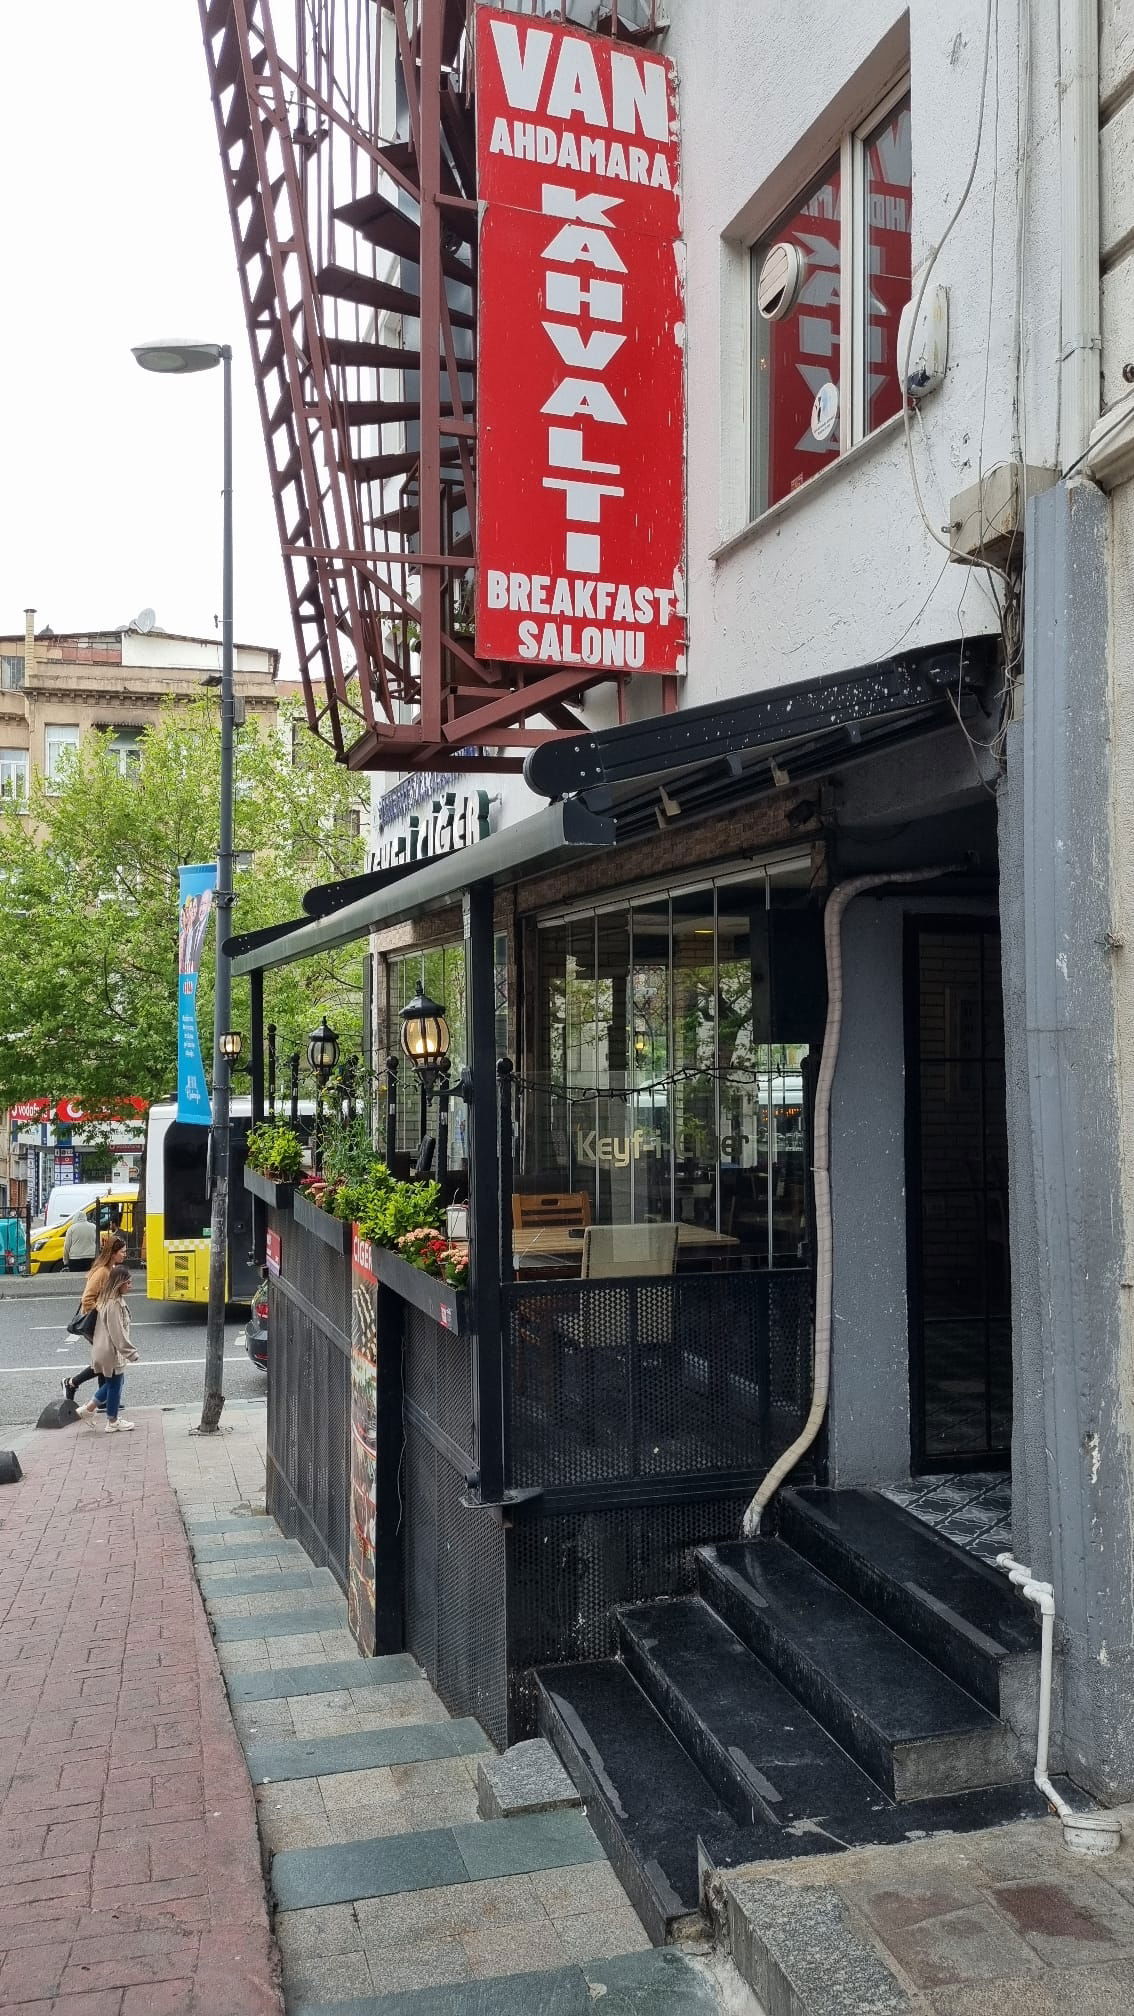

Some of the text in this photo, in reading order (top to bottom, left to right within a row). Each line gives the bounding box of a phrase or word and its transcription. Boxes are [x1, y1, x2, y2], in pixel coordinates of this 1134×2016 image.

[489, 19, 669, 143] VAN
[489, 117, 672, 191] AHDAMARA
[539, 183, 629, 574] KAHVALTI
[488, 570, 675, 626] BREAKFAST
[518, 620, 645, 668] SALONU
